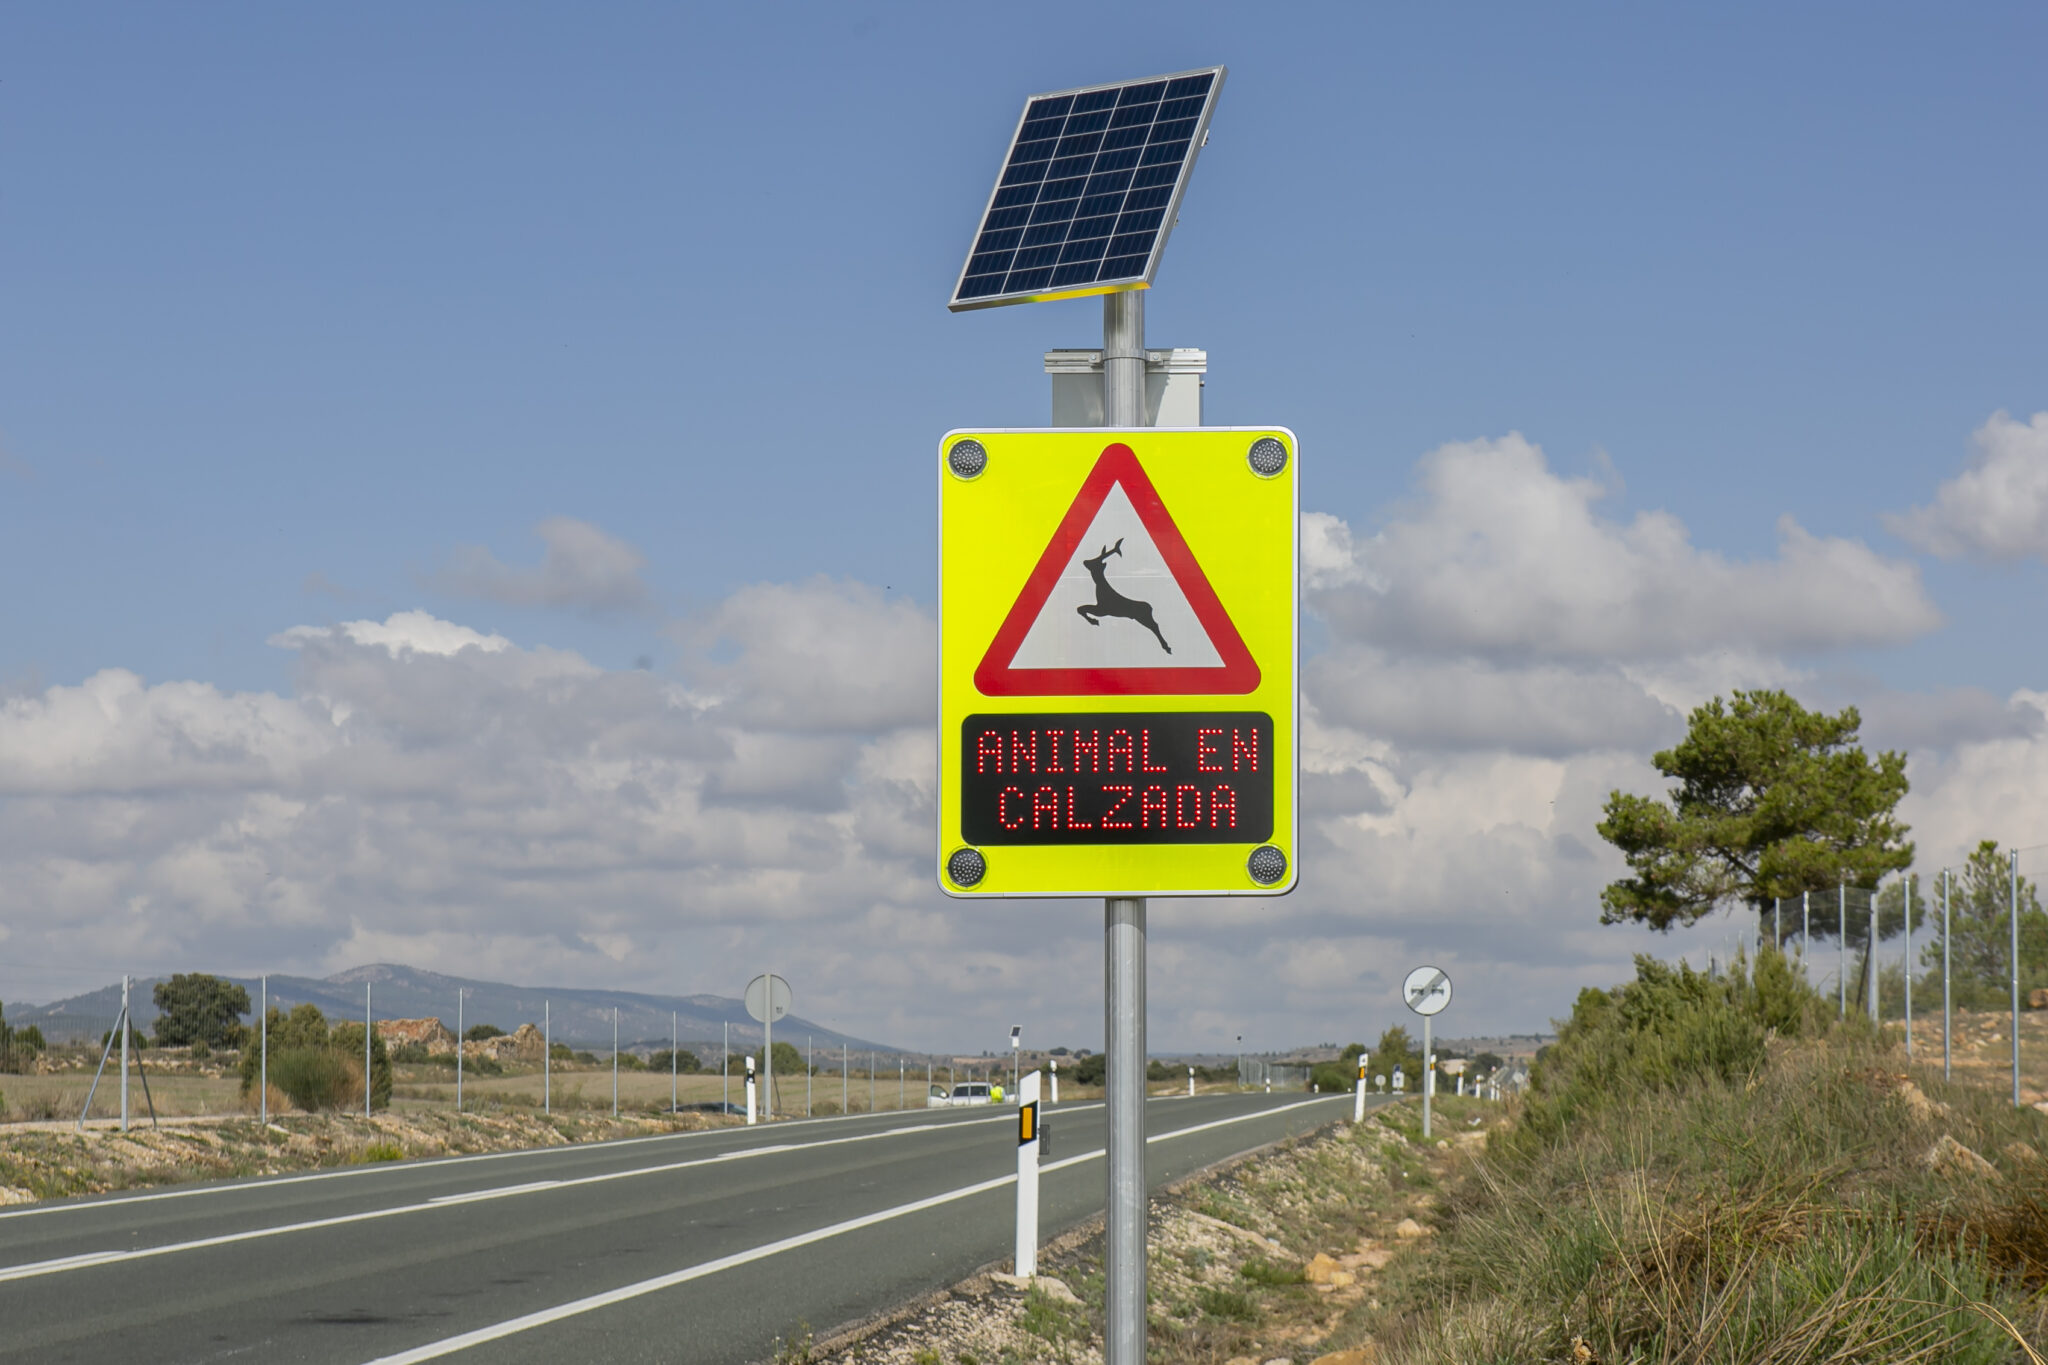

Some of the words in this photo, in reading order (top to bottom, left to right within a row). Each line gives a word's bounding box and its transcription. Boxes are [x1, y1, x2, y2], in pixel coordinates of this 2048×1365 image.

[977, 729, 1167, 773] ANIMAL
[1198, 728, 1258, 772] EN
[999, 784, 1236, 829] CALZADA
